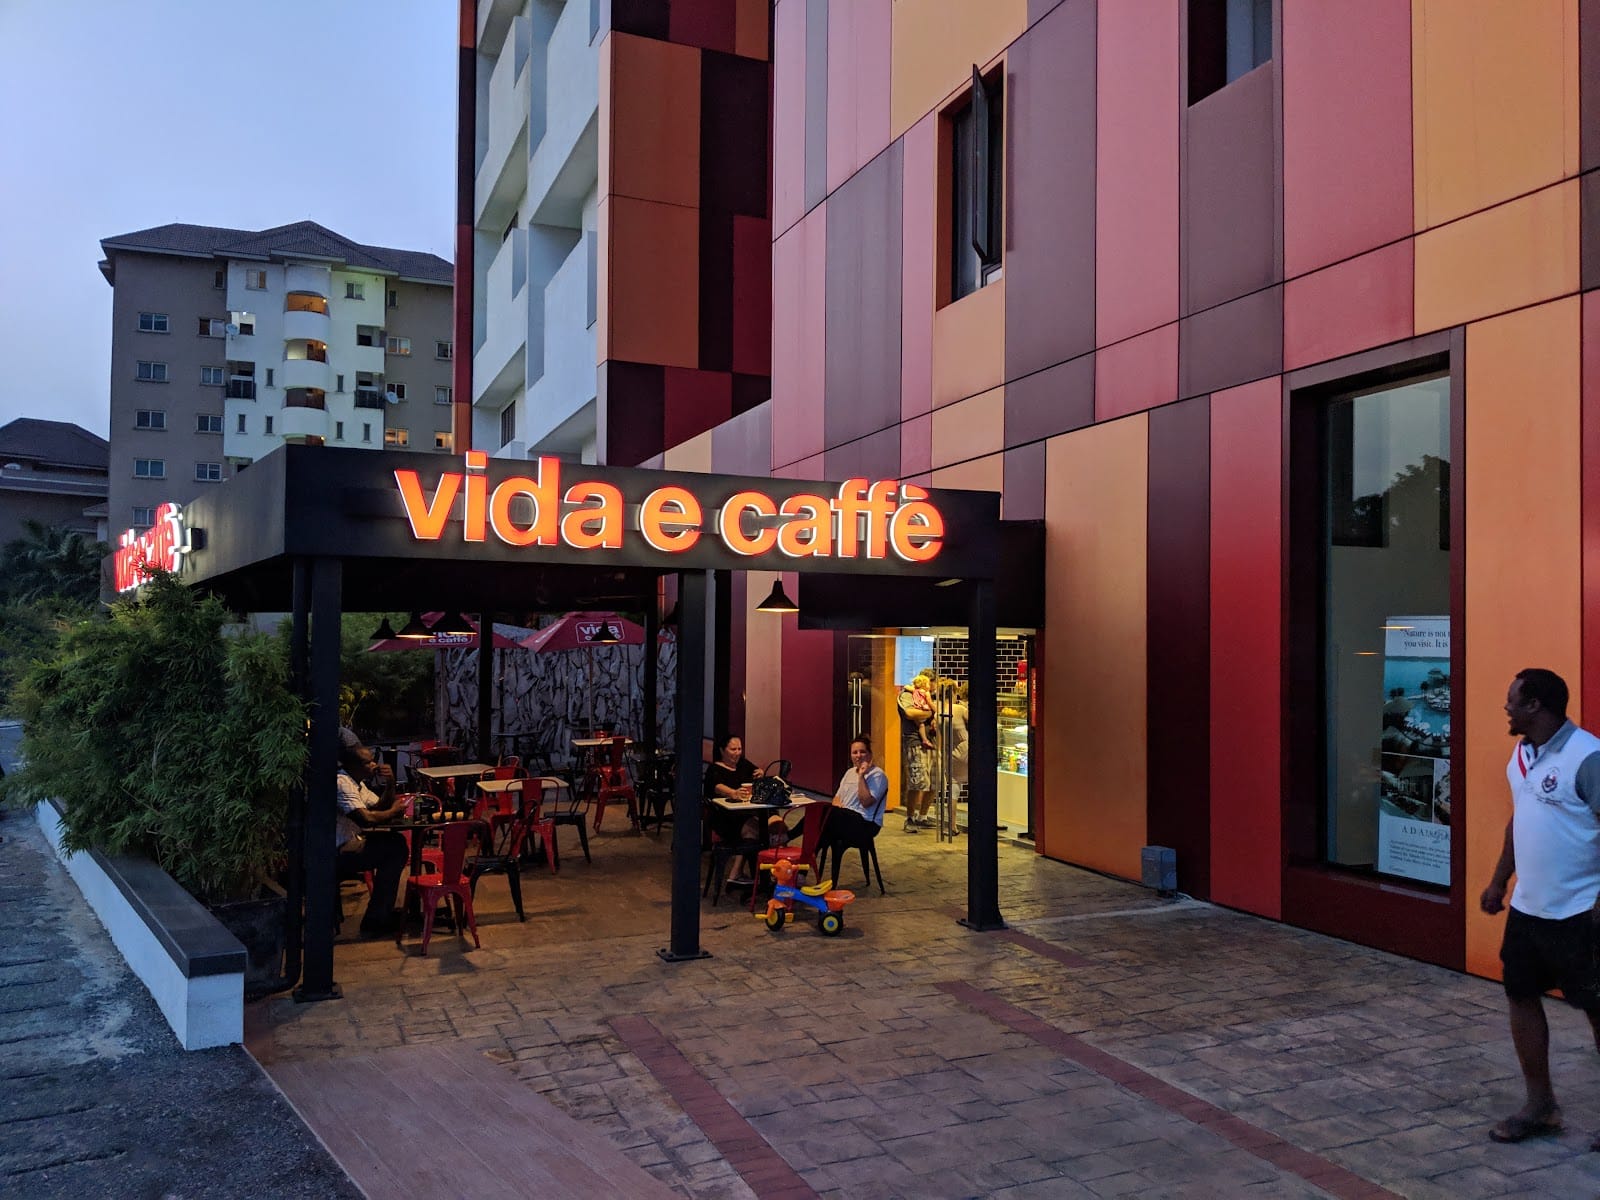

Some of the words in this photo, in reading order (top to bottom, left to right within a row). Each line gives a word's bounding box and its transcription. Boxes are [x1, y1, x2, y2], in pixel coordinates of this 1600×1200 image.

[394, 451, 624, 549] vida
[639, 486, 703, 553] e
[720, 478, 945, 563] caffè
[580, 623, 619, 635] via
